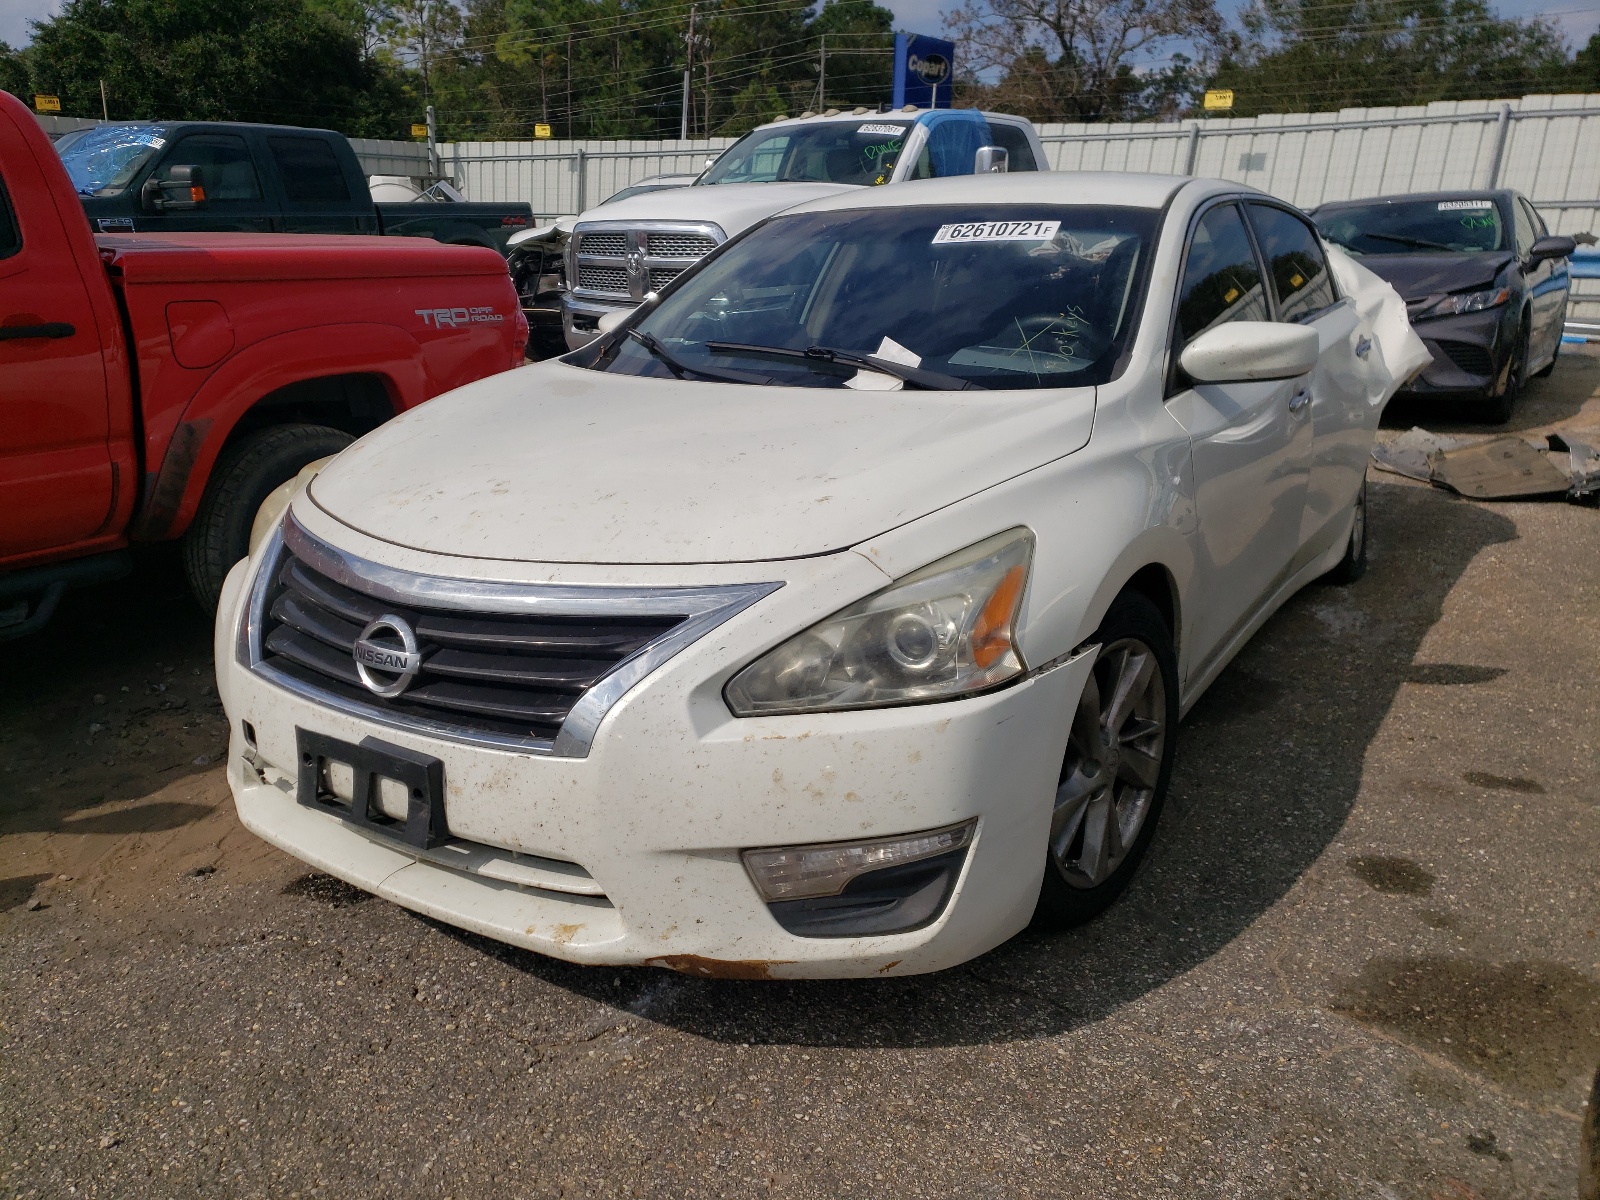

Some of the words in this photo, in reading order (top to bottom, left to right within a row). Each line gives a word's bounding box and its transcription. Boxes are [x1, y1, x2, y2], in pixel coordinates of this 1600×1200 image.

[908, 54, 946, 77] Copart
[414, 307, 470, 329] TRD
[469, 306, 493, 314] OFF
[471, 314, 504, 322] ROAD
[355, 646, 408, 669] NISSAN
